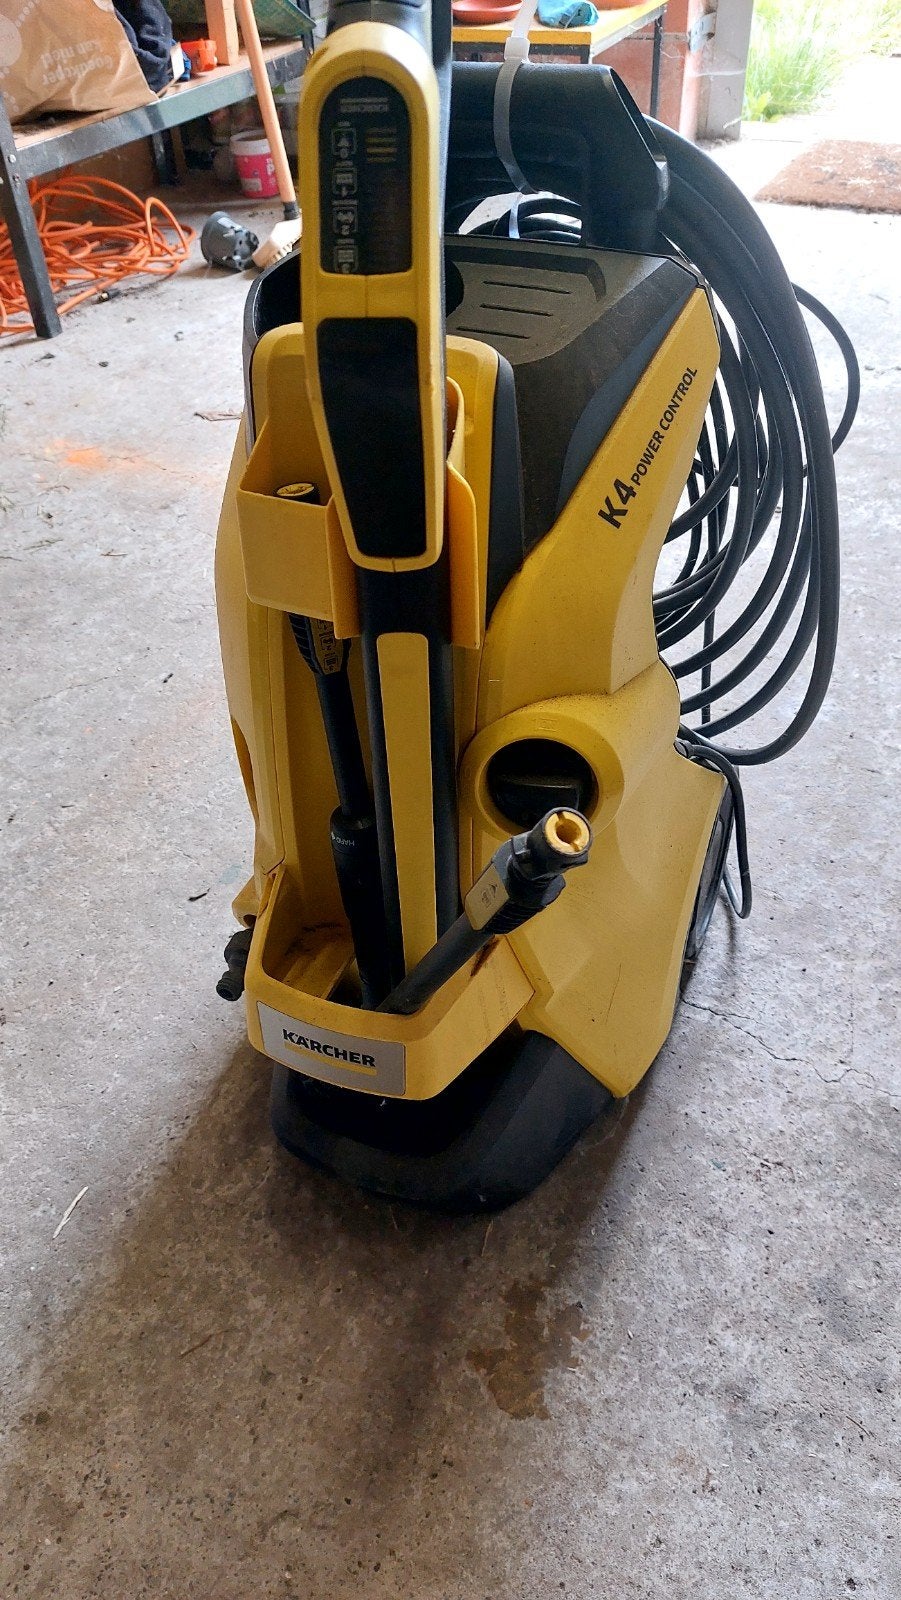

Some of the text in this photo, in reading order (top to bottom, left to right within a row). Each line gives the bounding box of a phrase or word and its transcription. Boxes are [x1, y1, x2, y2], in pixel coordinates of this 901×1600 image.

[630, 430, 665, 486] POWER
[659, 367, 698, 431] CONTROL
[335, 836, 355, 847] HARD
[282, 1028, 376, 1067] KÄRCHER
